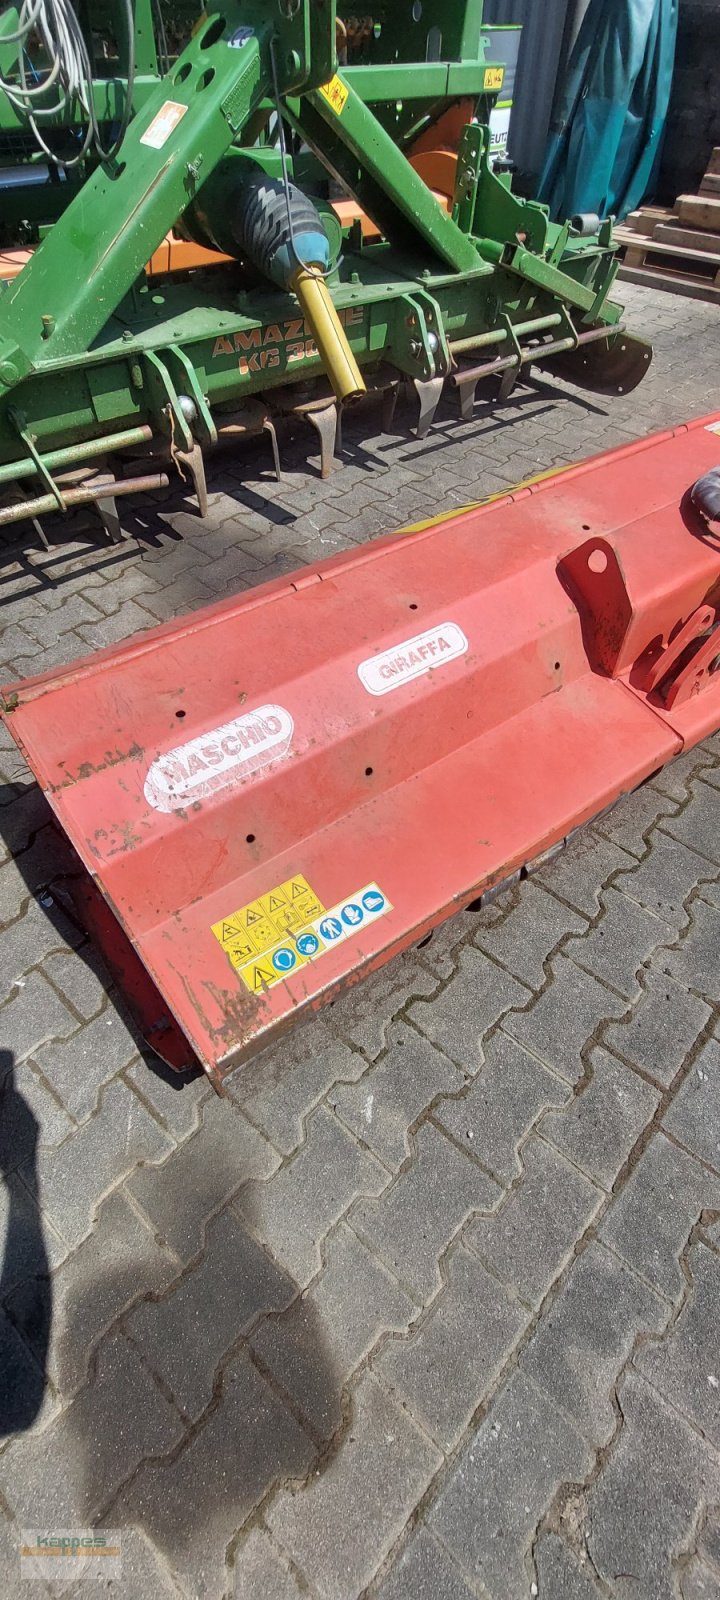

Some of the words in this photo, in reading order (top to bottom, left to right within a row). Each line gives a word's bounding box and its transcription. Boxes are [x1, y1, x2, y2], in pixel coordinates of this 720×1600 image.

[212, 305, 364, 357] AMAZE
[238, 348, 280, 375] KG
[378, 637, 452, 679] GIRAFFA
[160, 715, 282, 788] MASCHIO
